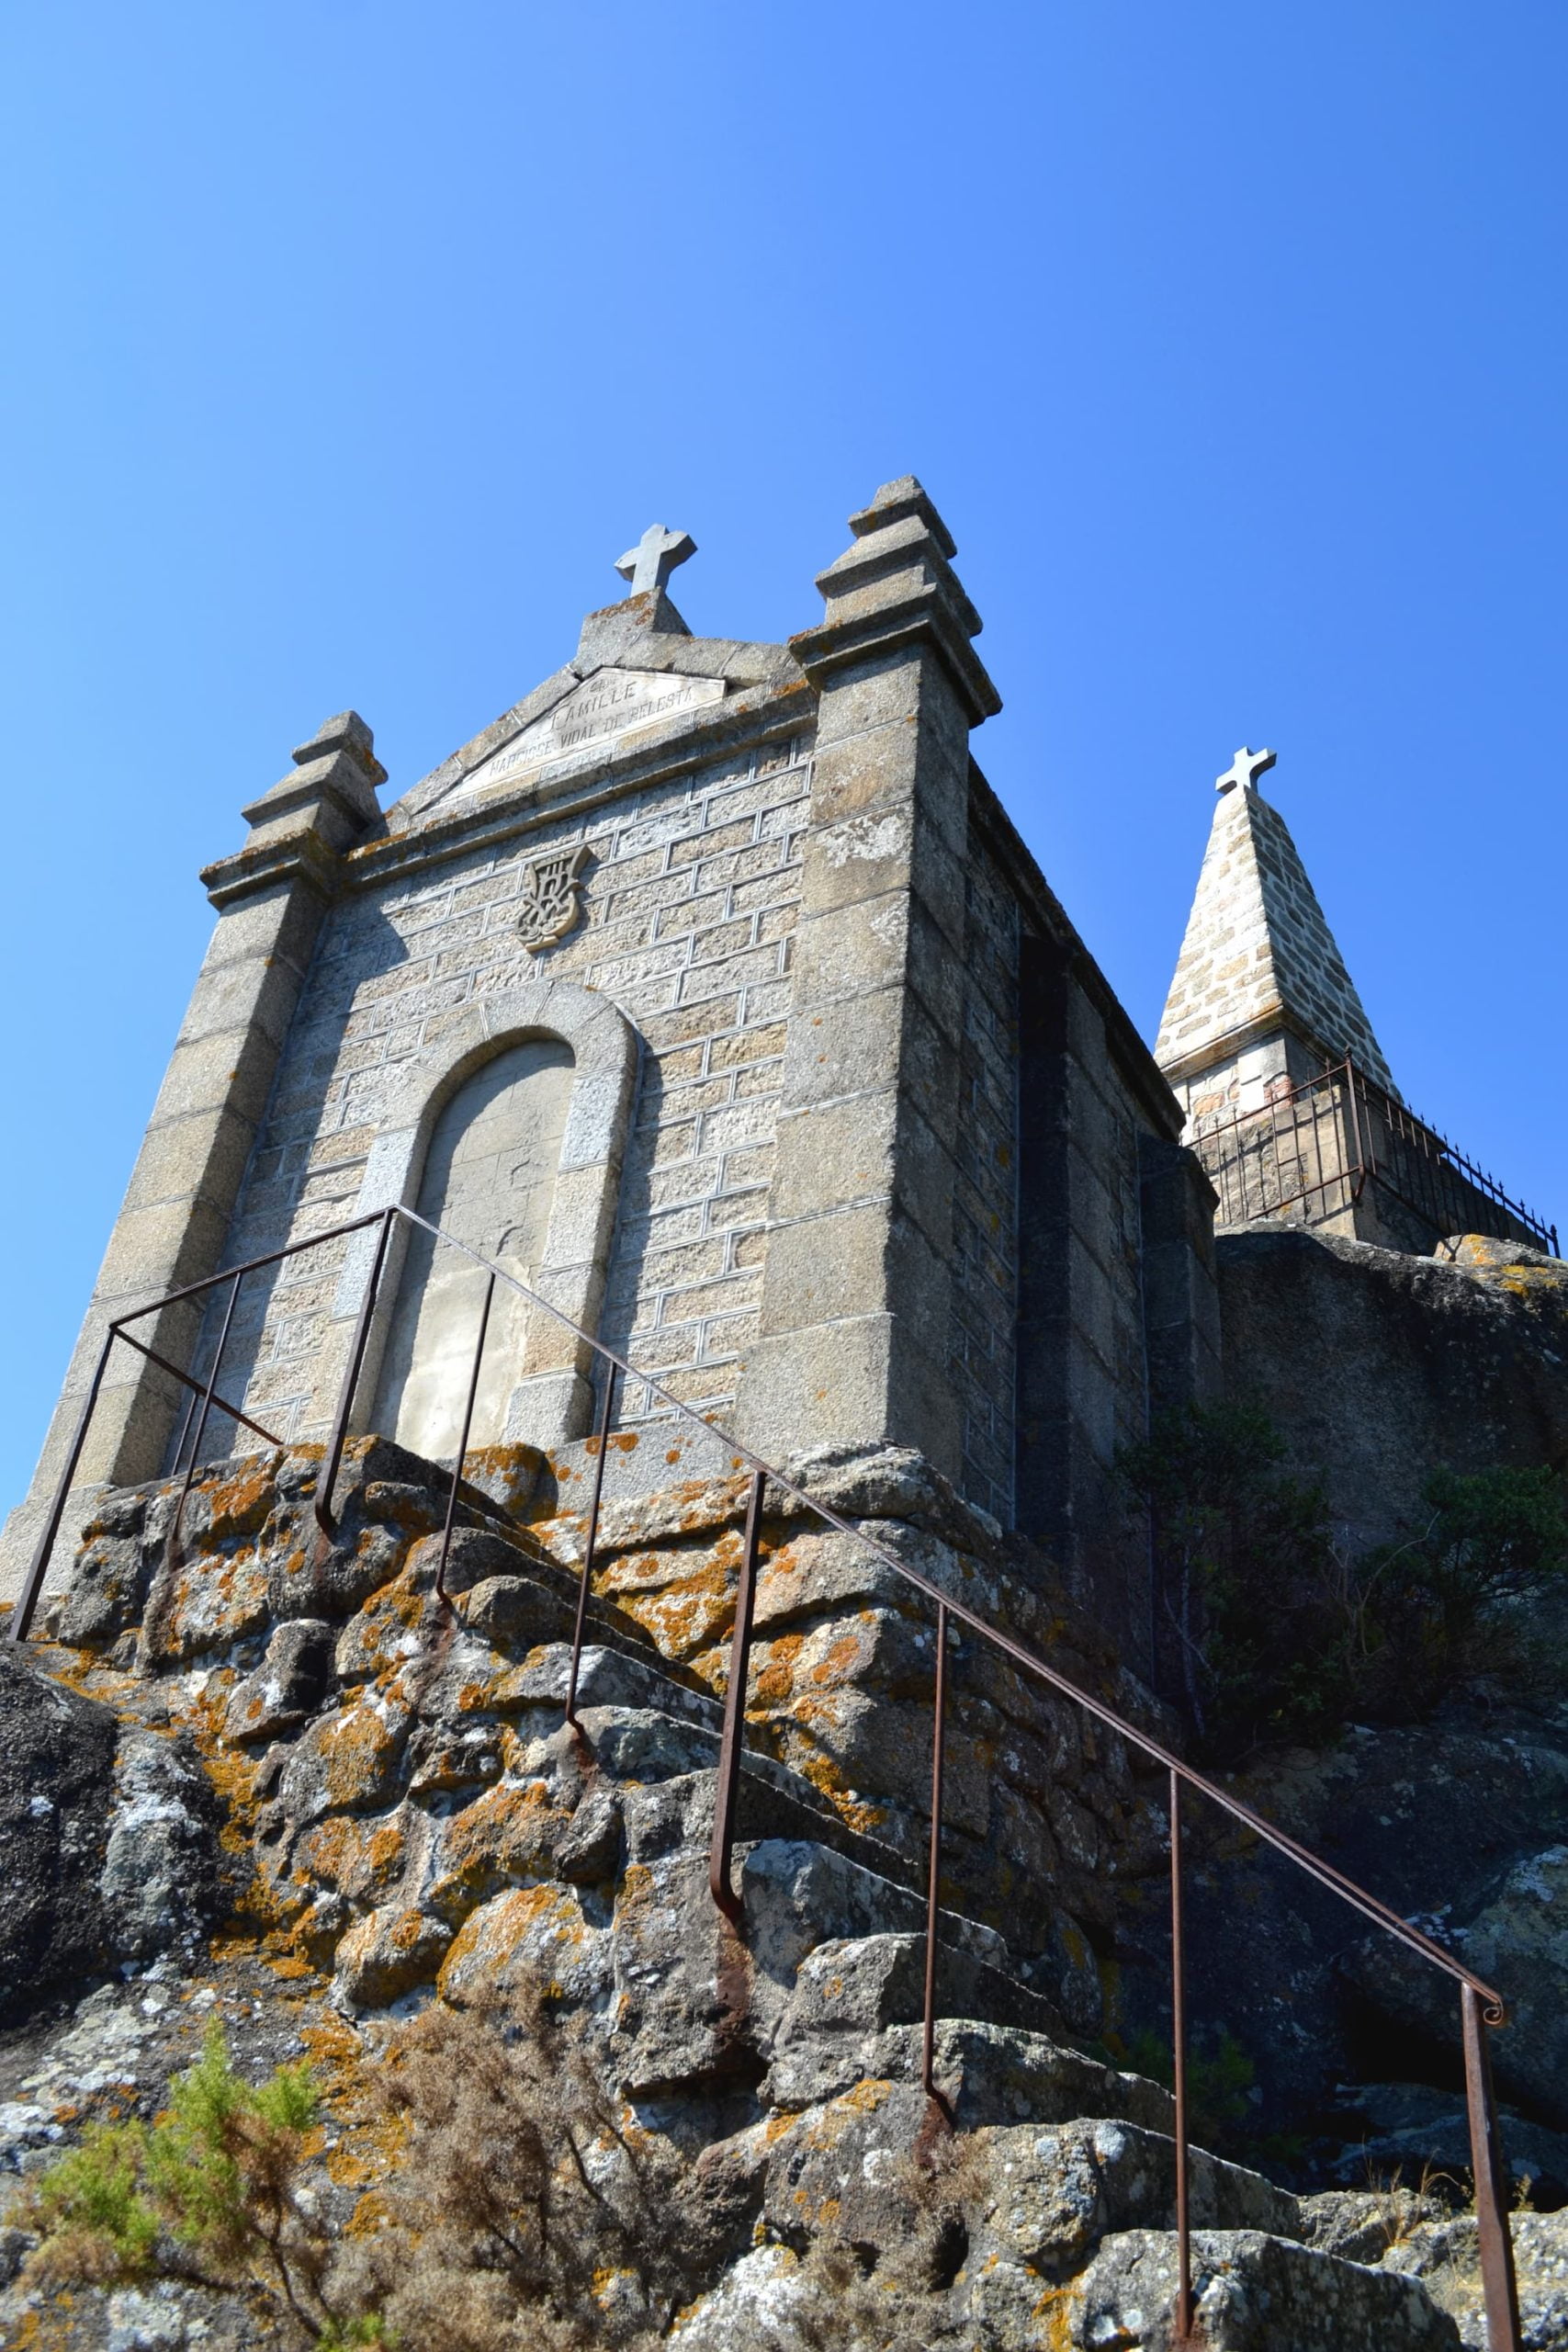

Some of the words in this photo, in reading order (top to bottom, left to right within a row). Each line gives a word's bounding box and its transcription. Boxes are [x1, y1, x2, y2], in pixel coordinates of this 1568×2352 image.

[547, 680, 637, 732] FAMILLE
[560, 723, 596, 749] VIDAL
[604, 712, 626, 733] DE
[628, 685, 693, 724] BELESTA
